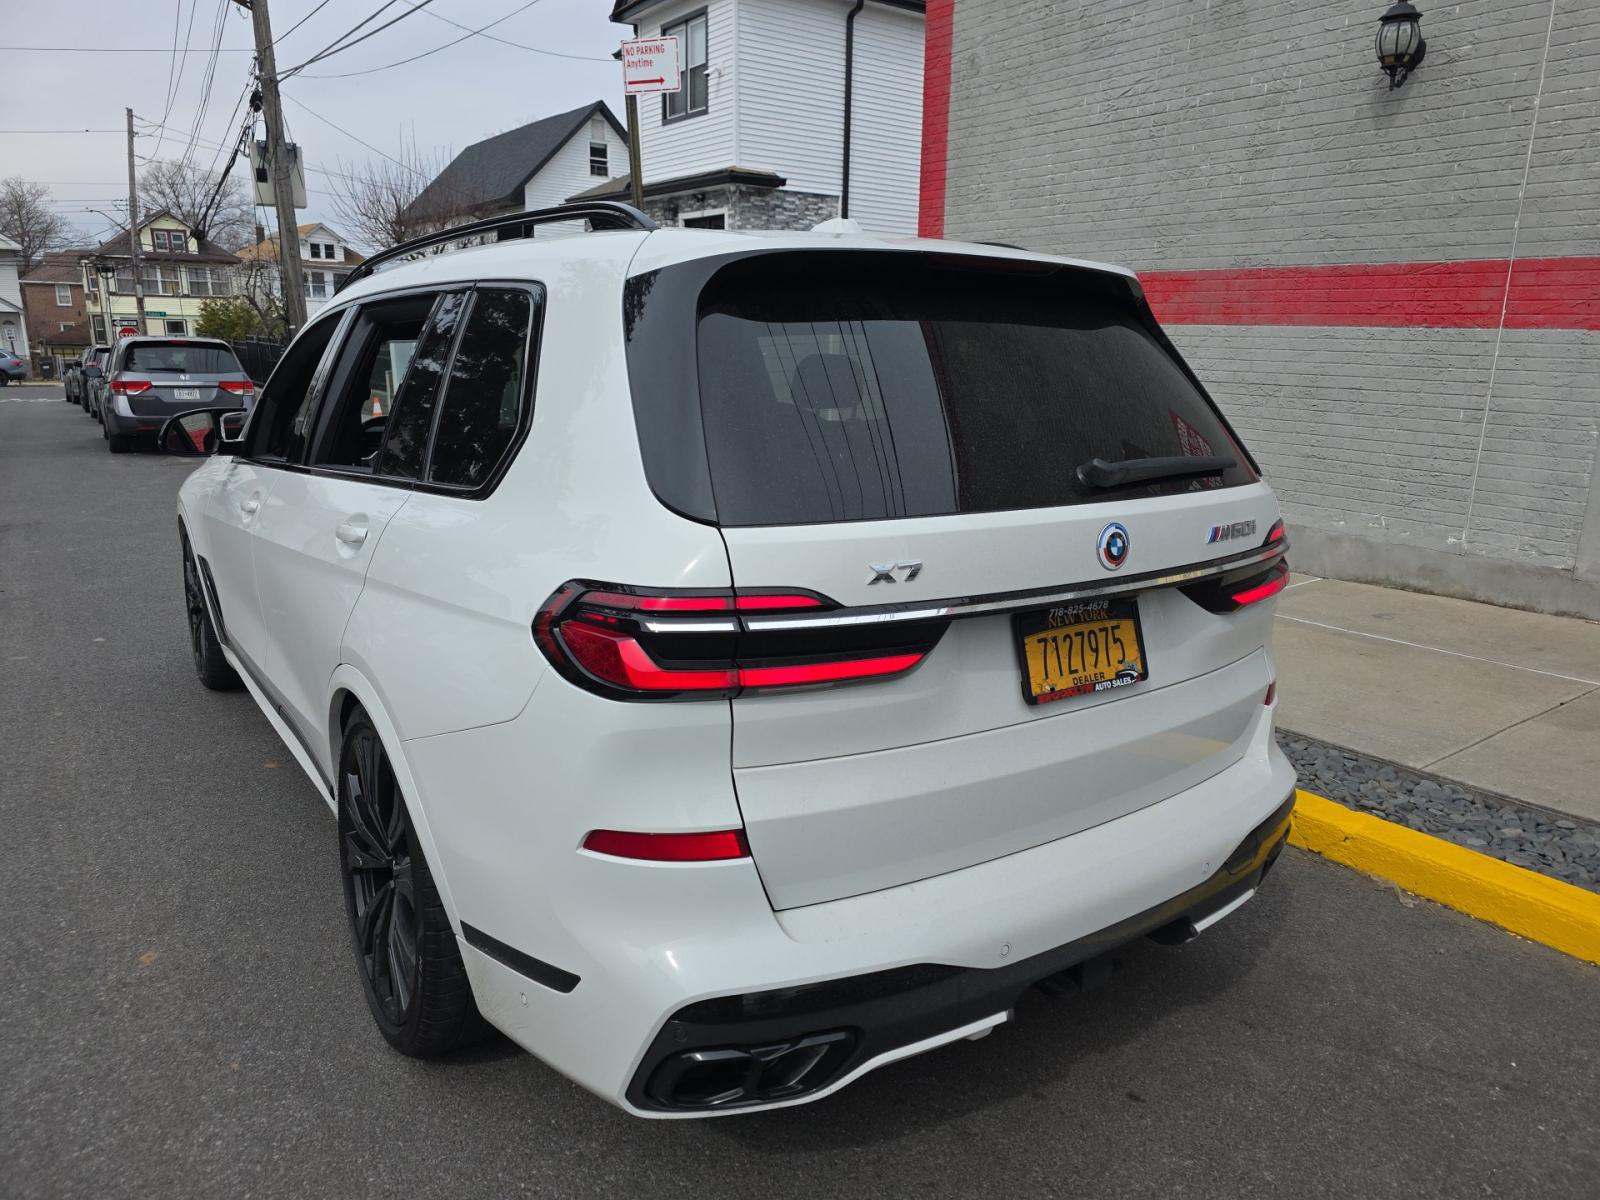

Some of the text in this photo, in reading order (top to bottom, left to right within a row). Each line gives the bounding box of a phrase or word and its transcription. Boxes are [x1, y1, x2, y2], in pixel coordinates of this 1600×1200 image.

[625, 43, 665, 56] NO PARKING
[626, 58, 654, 69] Anytime
[866, 560, 923, 586] X7
[1037, 624, 1126, 680] 7127975
[1072, 671, 1106, 686] DEALER
[1095, 676, 1132, 692] AUTO SALES
